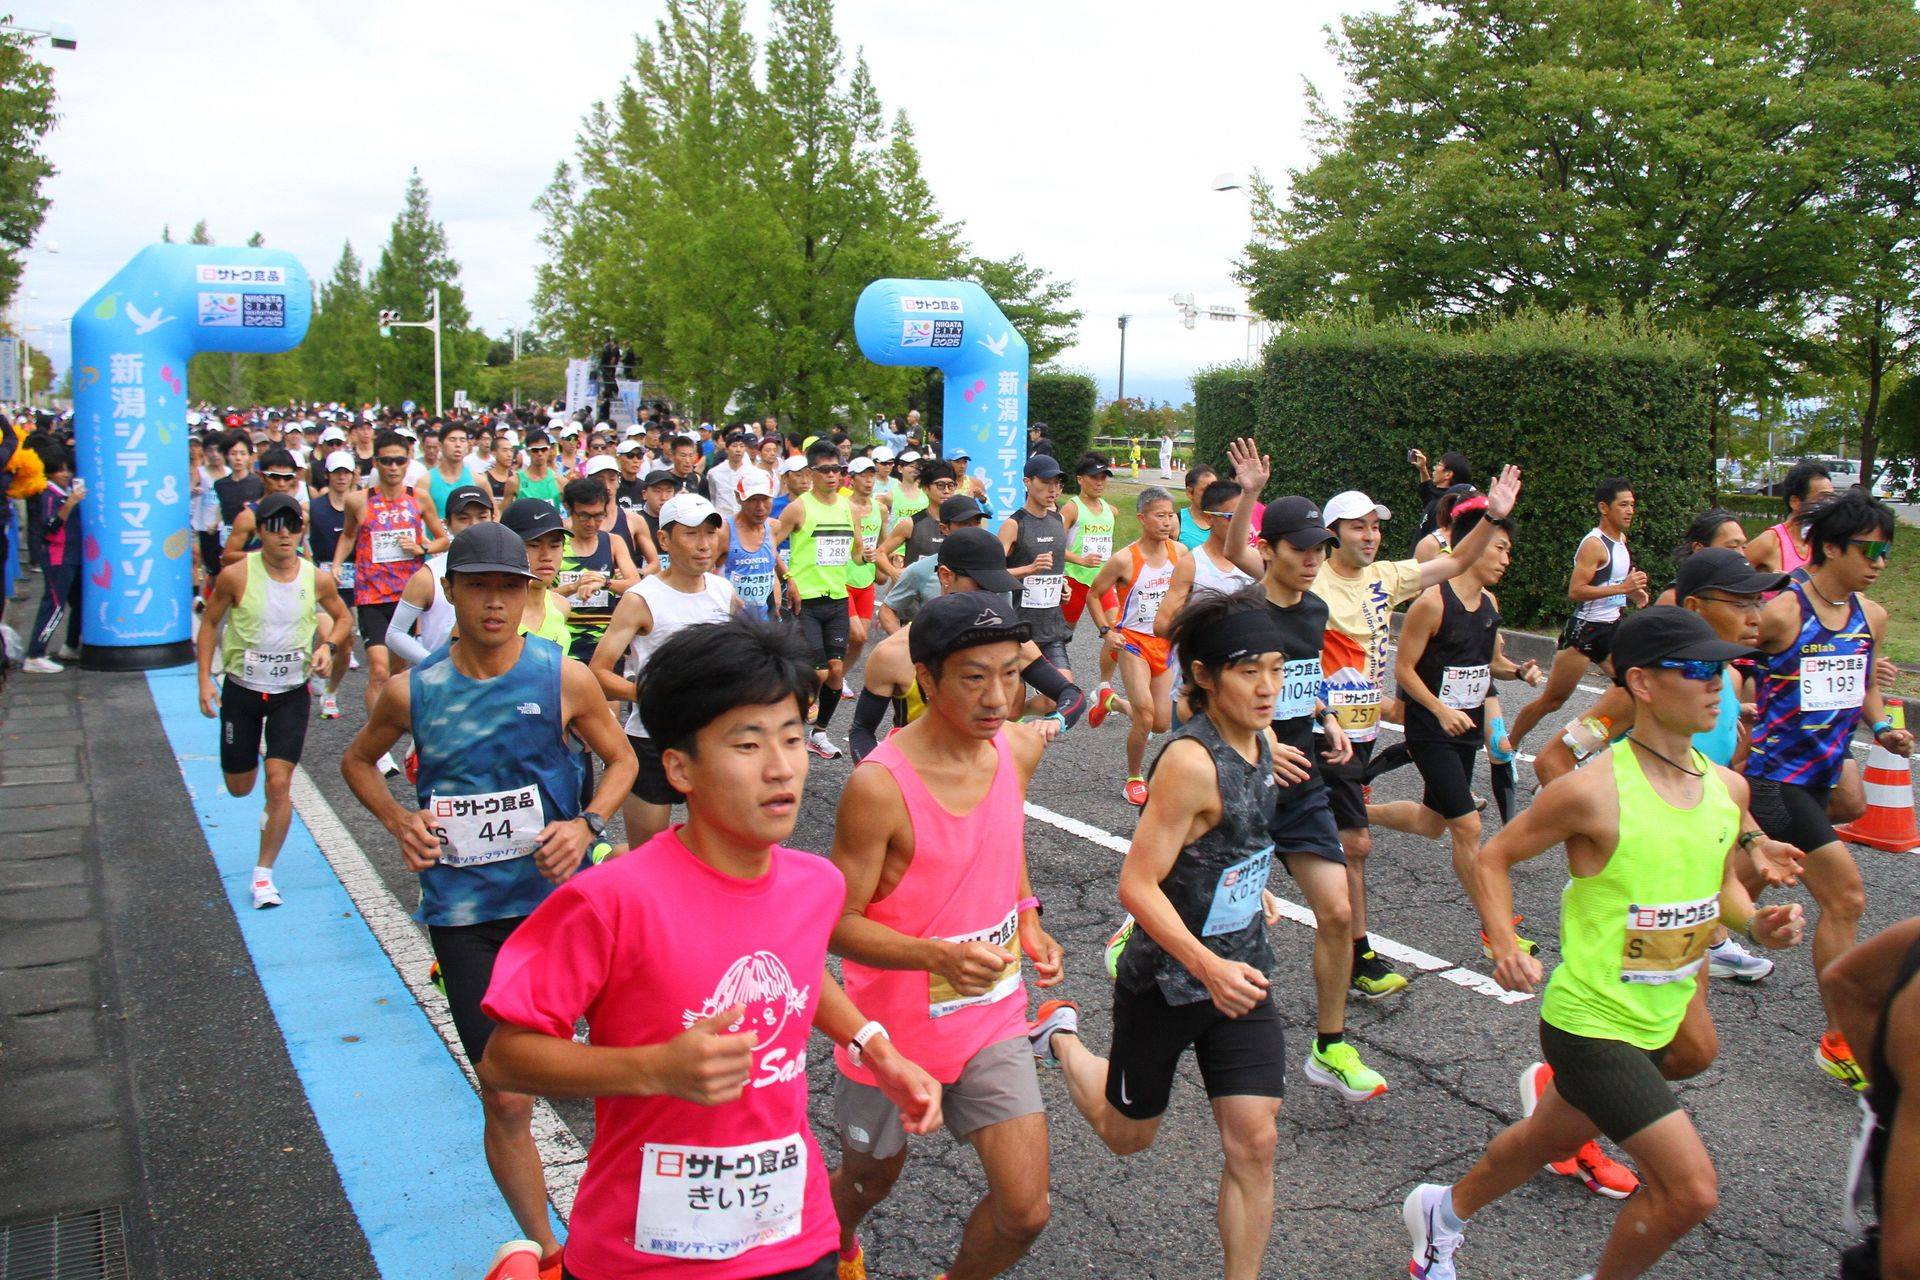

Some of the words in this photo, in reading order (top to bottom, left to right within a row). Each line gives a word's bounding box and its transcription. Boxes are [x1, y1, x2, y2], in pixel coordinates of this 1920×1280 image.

[217, 269, 281, 282] サトウ食品
[915, 299, 960, 311] サトウ食品
[244, 317, 283, 327] 2025
[932, 339, 961, 347] 2025
[109, 352, 154, 615] 新潟シティマラソン
[829, 547, 846, 557] 288
[1043, 587, 1055, 599] 17
[1140, 603, 1147, 613] S
[259, 652, 301, 663] サトウ食品
[1817, 657, 1864, 672] サトウ食品
[245, 665, 254, 676] S
[269, 666, 289, 678] 49
[1441, 684, 1451, 696] S
[1466, 682, 1480, 697] 14
[1803, 679, 1813, 695] S
[1825, 675, 1855, 693] 193
[1350, 707, 1376, 724] 257
[453, 791, 535, 817] サトウ食品
[478, 819, 514, 842] 44
[1627, 938, 1644, 960] S
[1682, 932, 1696, 957] 7
[686, 1143, 799, 1180] サトウ食品
[687, 1183, 772, 1211] きいち
